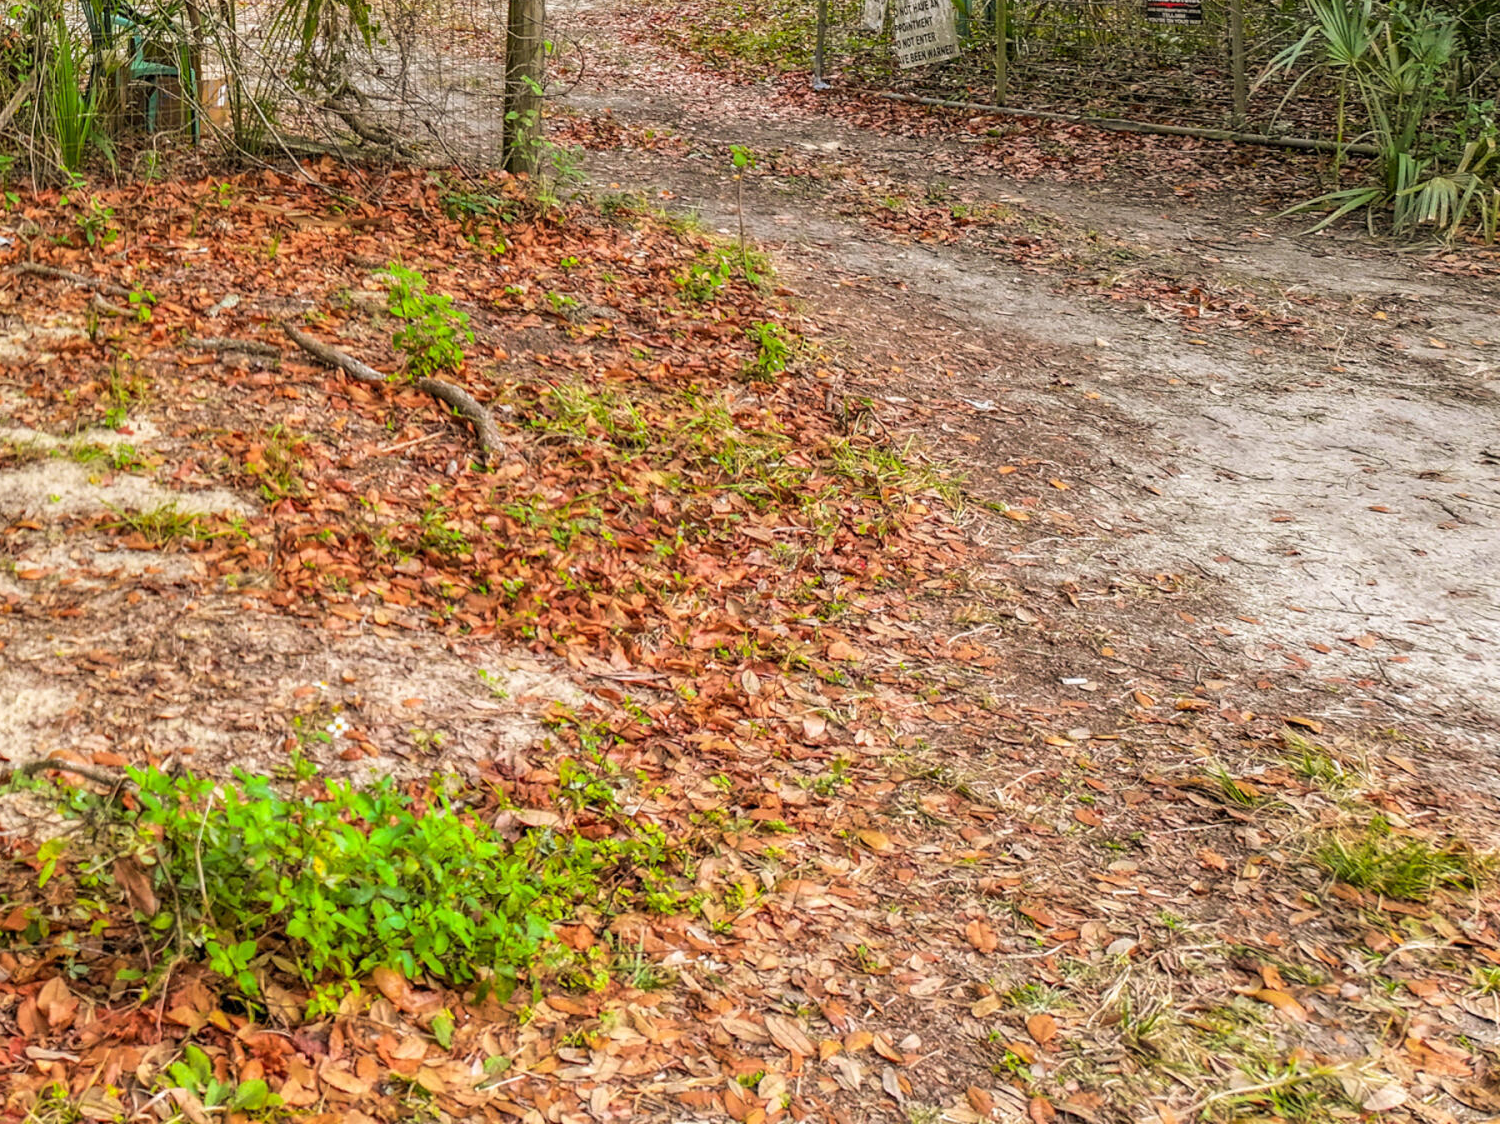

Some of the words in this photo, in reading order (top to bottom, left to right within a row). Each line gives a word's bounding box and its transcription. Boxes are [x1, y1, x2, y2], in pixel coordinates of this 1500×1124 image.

[899, 5, 912, 17] NOT
[913, 0, 930, 14] HAVE
[902, 36, 915, 49] NOT
[916, 31, 937, 46] ENTER
[910, 50, 927, 64] BEEN
